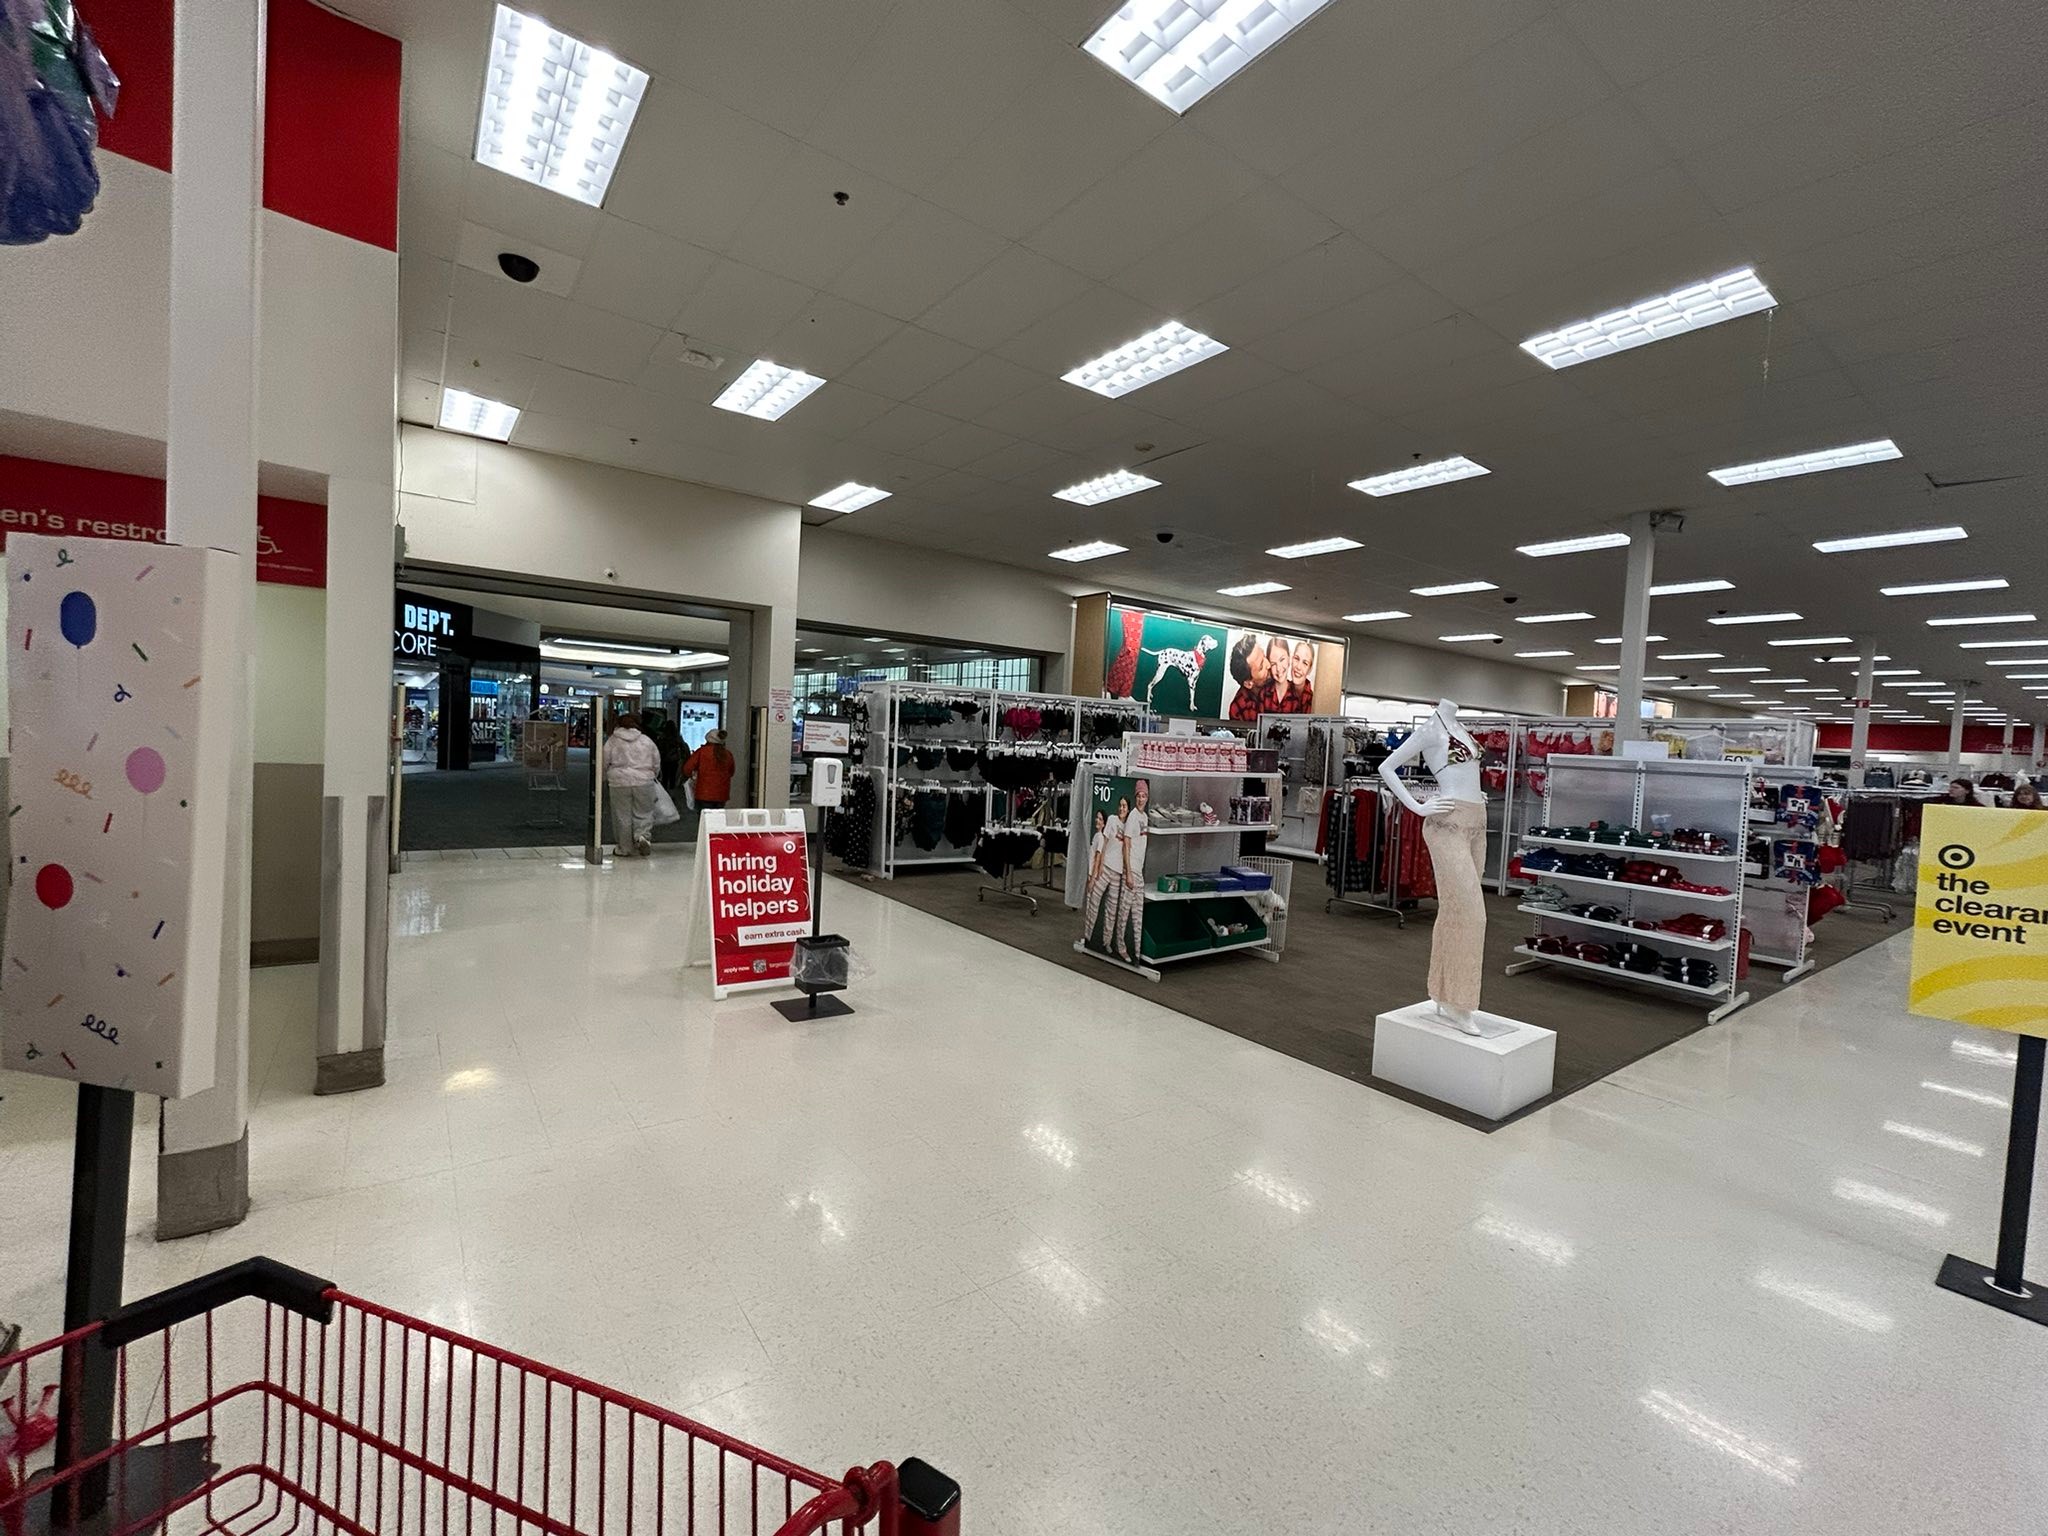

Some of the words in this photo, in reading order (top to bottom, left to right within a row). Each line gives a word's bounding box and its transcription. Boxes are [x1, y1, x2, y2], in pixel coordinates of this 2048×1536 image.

[404, 603, 455, 637] DEPT.
[1094, 785, 1110, 802] $10
[718, 852, 777, 873] hiring
[719, 874, 794, 895] holiday
[1936, 872, 1990, 895] the
[720, 898, 799, 920] helpers
[745, 932, 763, 940] earn
[765, 930, 785, 938] extra
[786, 928, 807, 936] cash.
[1933, 918, 2026, 945] event
